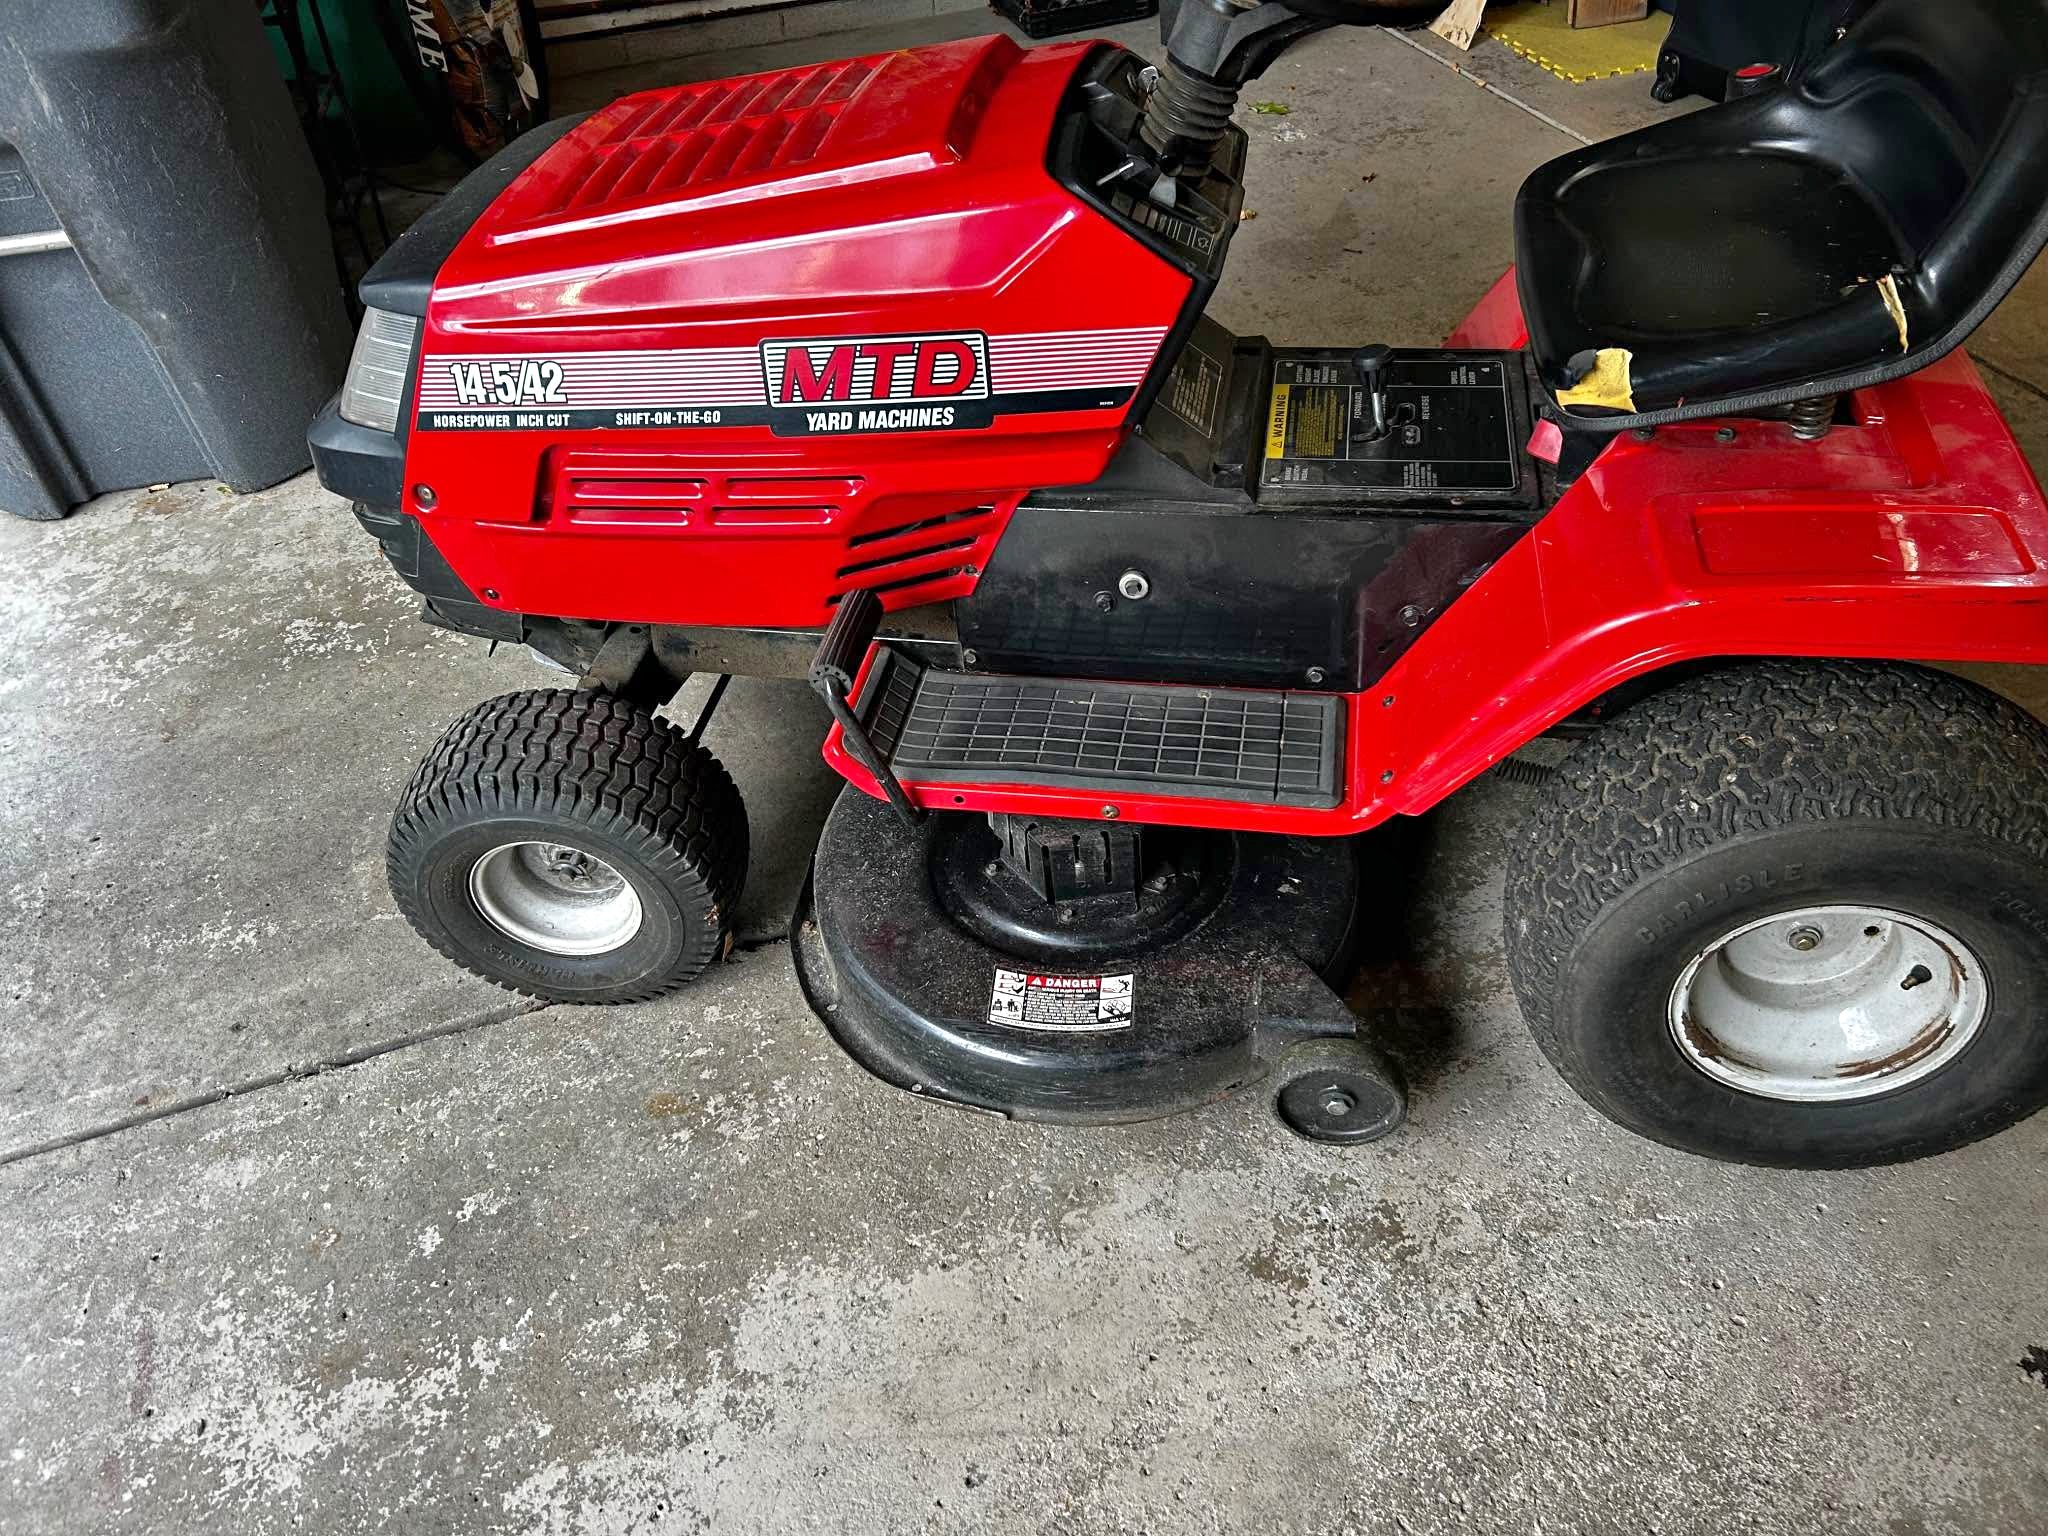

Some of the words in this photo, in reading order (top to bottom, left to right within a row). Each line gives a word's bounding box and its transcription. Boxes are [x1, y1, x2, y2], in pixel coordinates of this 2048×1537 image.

[449, 359, 568, 406] 14.5/42
[780, 340, 978, 404] MTD
[1273, 394, 1287, 438] WARNING
[1354, 391, 1362, 419] FORWARD
[1421, 395, 1430, 420] REVERSE
[433, 414, 510, 428] HORSEPOWER
[516, 414, 544, 427] INCH
[547, 413, 570, 427] CUT
[615, 411, 721, 426] SHIFT-ON-THE-GO
[806, 411, 853, 431] YARD
[858, 407, 954, 430] MACHINES
[1636, 863, 1805, 944] CARLISLE
[1046, 977, 1097, 988] DANGER
